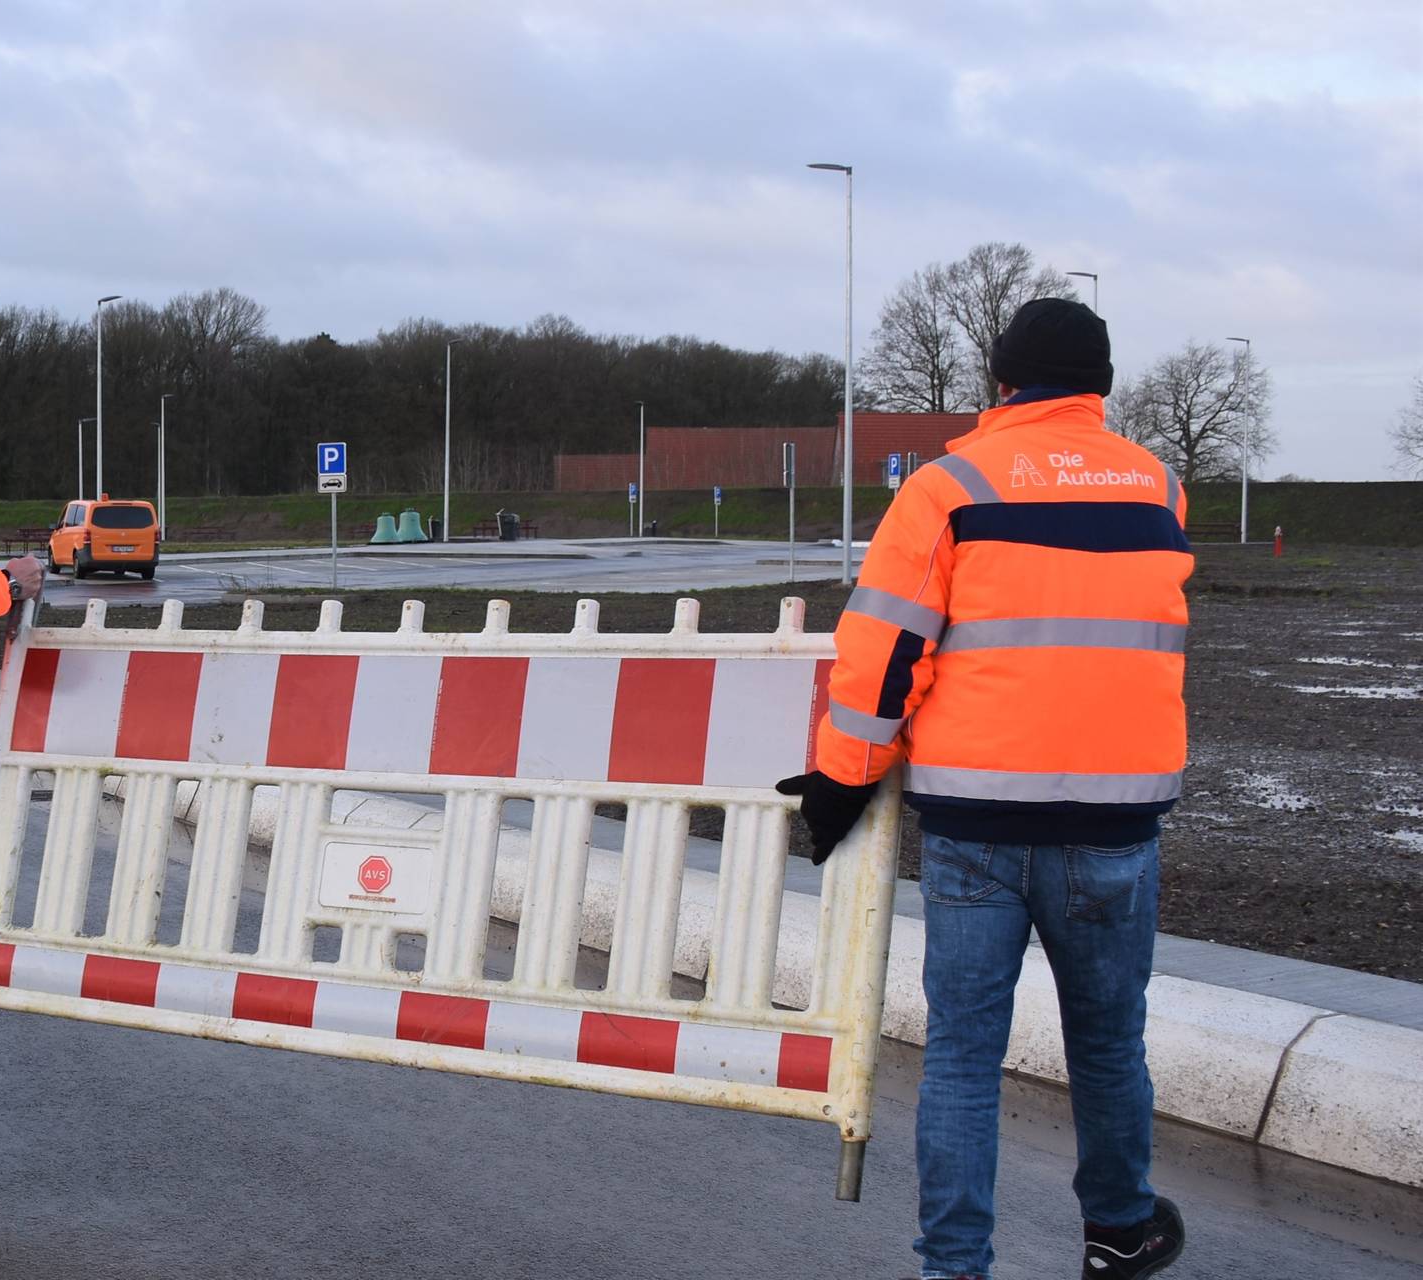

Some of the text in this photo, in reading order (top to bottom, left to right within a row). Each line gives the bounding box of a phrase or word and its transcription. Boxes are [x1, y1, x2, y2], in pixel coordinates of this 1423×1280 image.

[324, 447, 339, 471] P
[891, 457, 898, 474] P
[1048, 451, 1084, 468] Die
[1056, 468, 1156, 489] Autobahn
[364, 869, 386, 881] AVS
